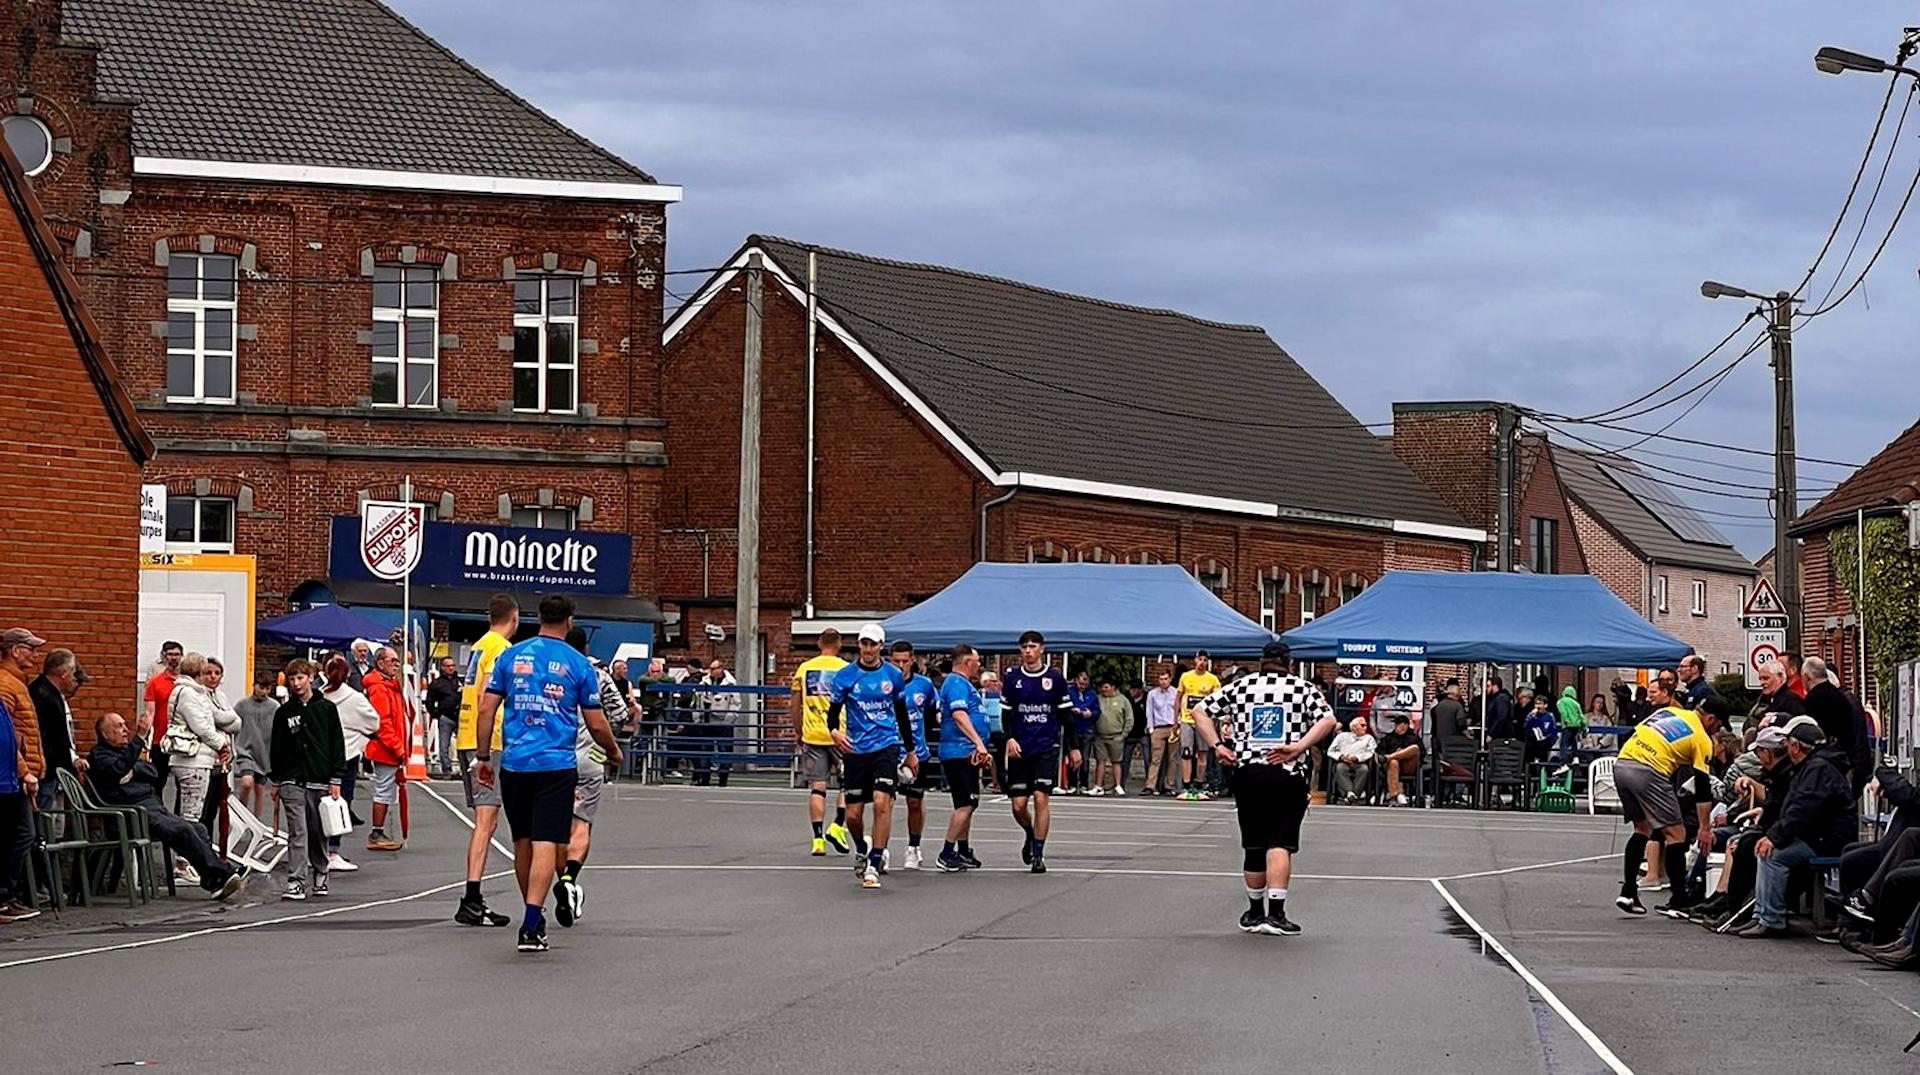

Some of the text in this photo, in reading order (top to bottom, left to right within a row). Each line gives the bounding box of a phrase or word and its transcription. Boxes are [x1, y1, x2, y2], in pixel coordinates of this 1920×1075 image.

[464, 531, 598, 573] Moinette
[463, 571, 597, 586] www.brasserie-dupont.com
[1749, 617, 1782, 628] 50 m
[1343, 643, 1376, 653] TOURPES
[1386, 645, 1424, 654] VISITEURS
[1352, 665, 1361, 678] 8
[1401, 667, 1410, 680] 6
[1349, 690, 1364, 702] 30
[1397, 691, 1413, 704] 40
